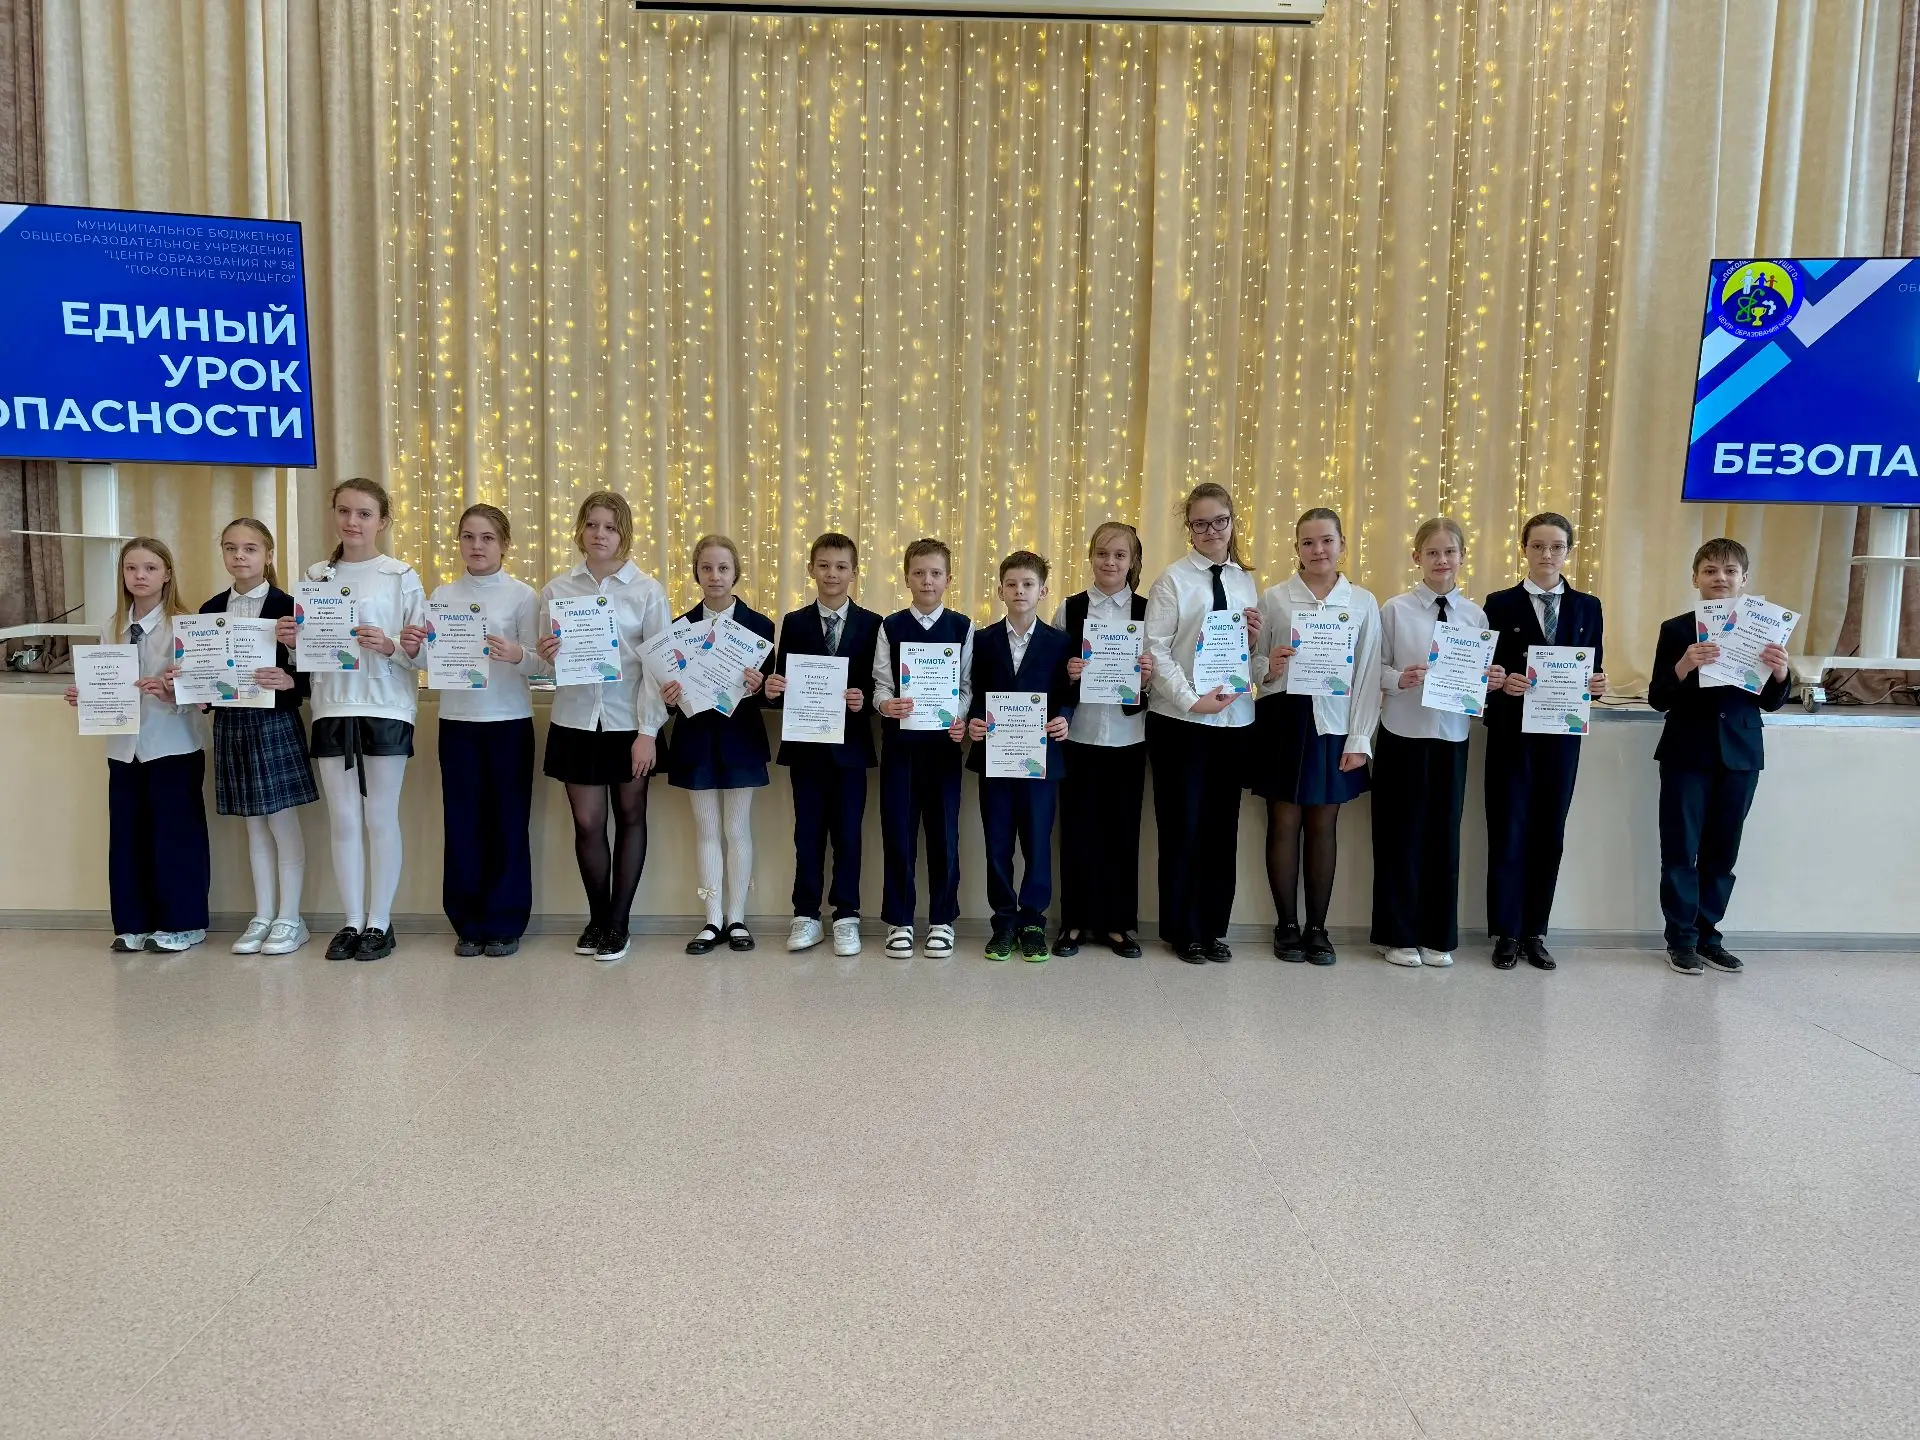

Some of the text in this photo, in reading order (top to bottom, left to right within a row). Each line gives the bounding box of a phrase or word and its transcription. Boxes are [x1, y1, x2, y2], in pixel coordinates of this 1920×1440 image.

[76, 219, 294, 243] МУНИЦИПАЛЬНОЕ БЮДЖЕТНОЕ
[20, 230, 295, 257] ОБЩЕОБРАЗОВАТЕЛЬНОЕ УЧРЕЖДЕНИЕ
[158, 252, 259, 268] ОБРАЗОВАНИЯ
[280, 261, 295, 270] 58
[61, 300, 297, 346] ЕДИНЫЙ
[158, 353, 303, 394] УРОК
[0, 395, 303, 440] ПАСНОСТИ
[1712, 442, 1919, 477] БЕЗОПА
[1746, 610, 1781, 628] ГРАМОТА
[187, 629, 219, 637] ГРАМОТА
[723, 632, 755, 654] ГРАМОТА
[1446, 636, 1481, 648] ГРАМОТА
[1542, 661, 1577, 669] ГРАМОТА
